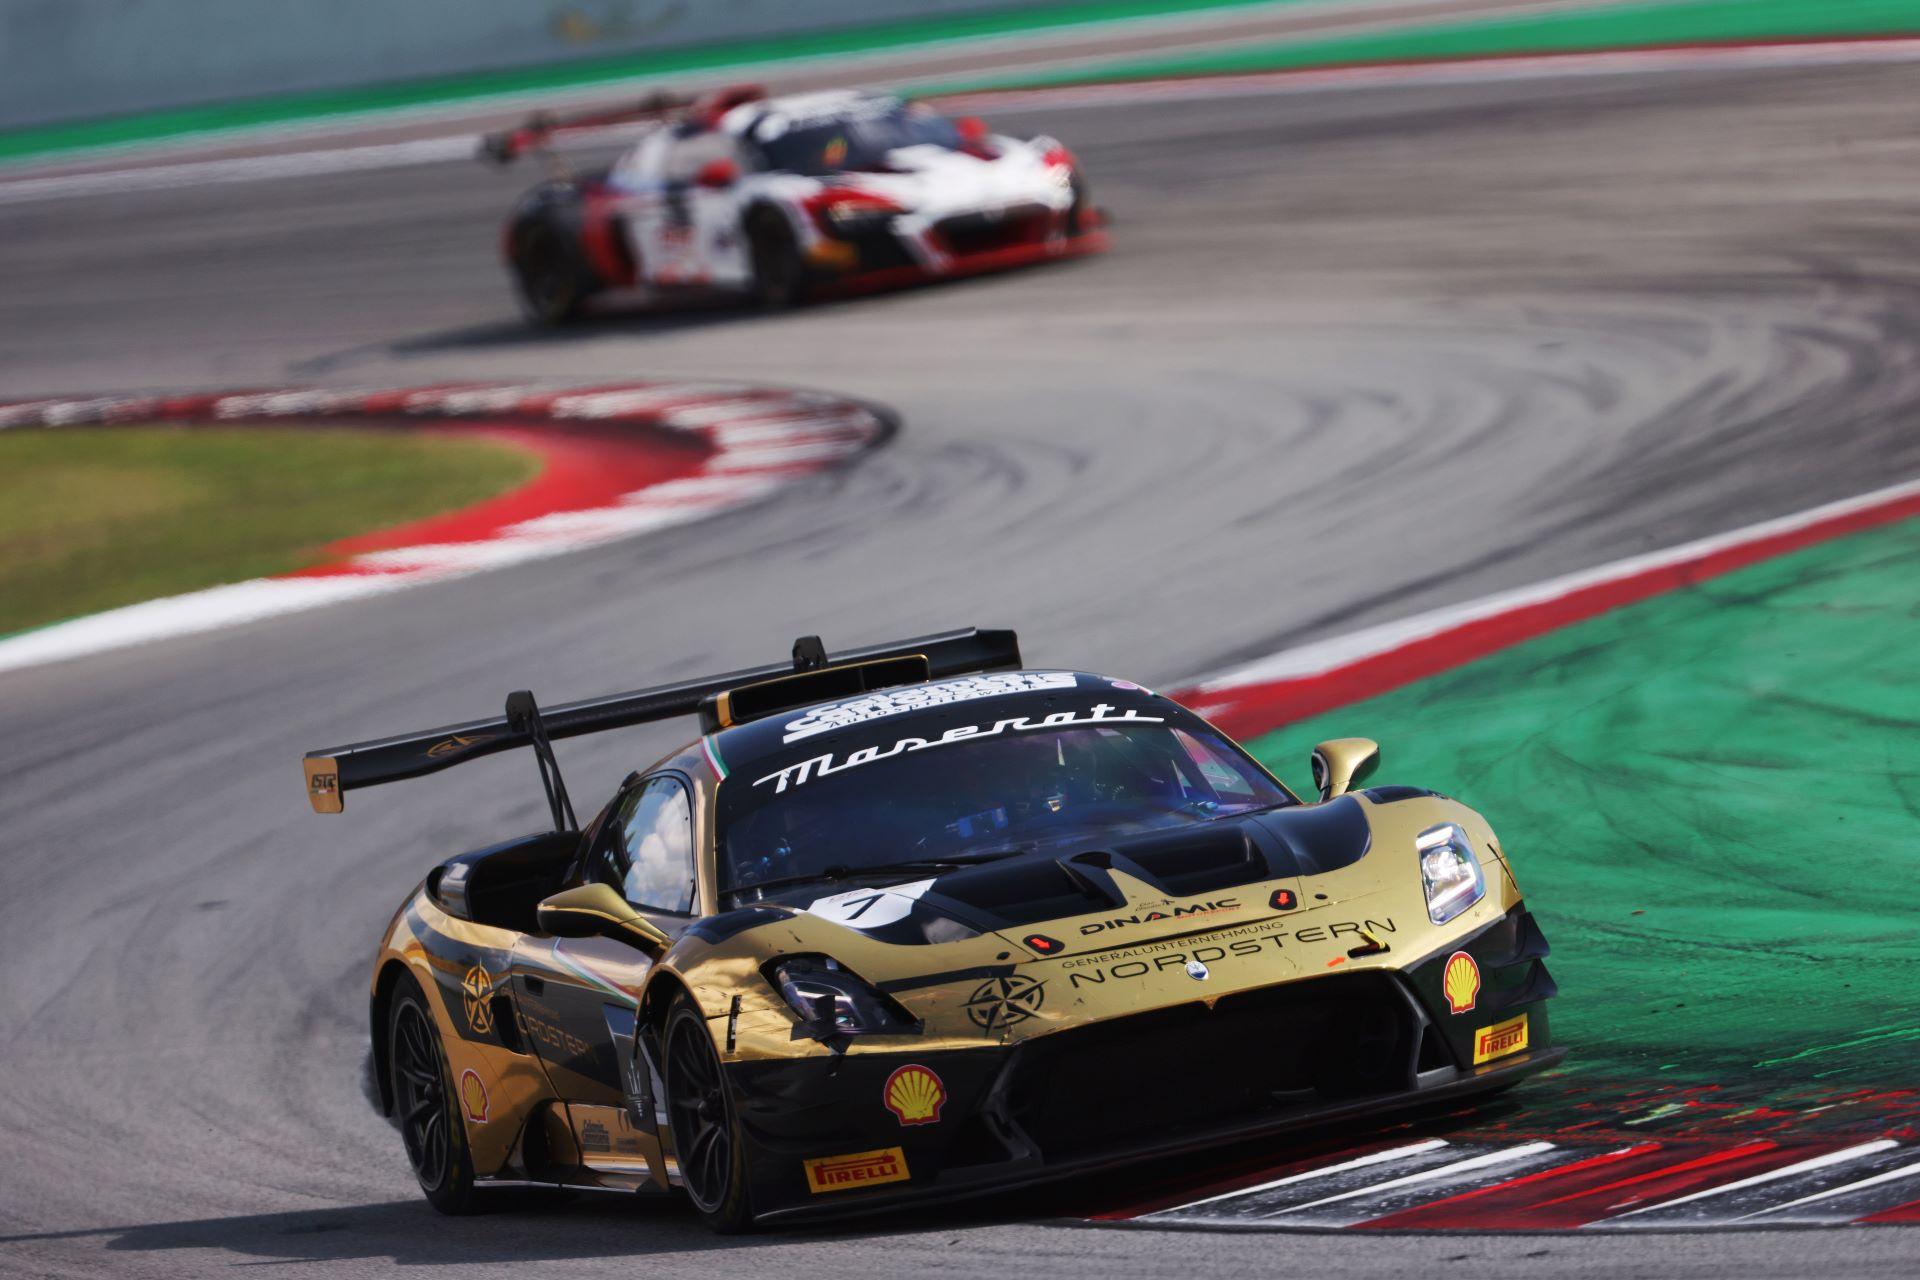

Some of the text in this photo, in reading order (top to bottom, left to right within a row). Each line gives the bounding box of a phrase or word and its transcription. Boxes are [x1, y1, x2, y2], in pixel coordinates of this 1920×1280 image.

[752, 703, 1165, 793] Maserati
[842, 892, 888, 921] 7
[1080, 897, 1242, 936] DINAMIC
[1062, 921, 1285, 969] GENERALUNTERNEHMUNG
[1069, 917, 1397, 988] NORDSTERN
[1479, 1021, 1524, 1056] PIRELLI
[813, 1155, 899, 1186] PIRELLI
